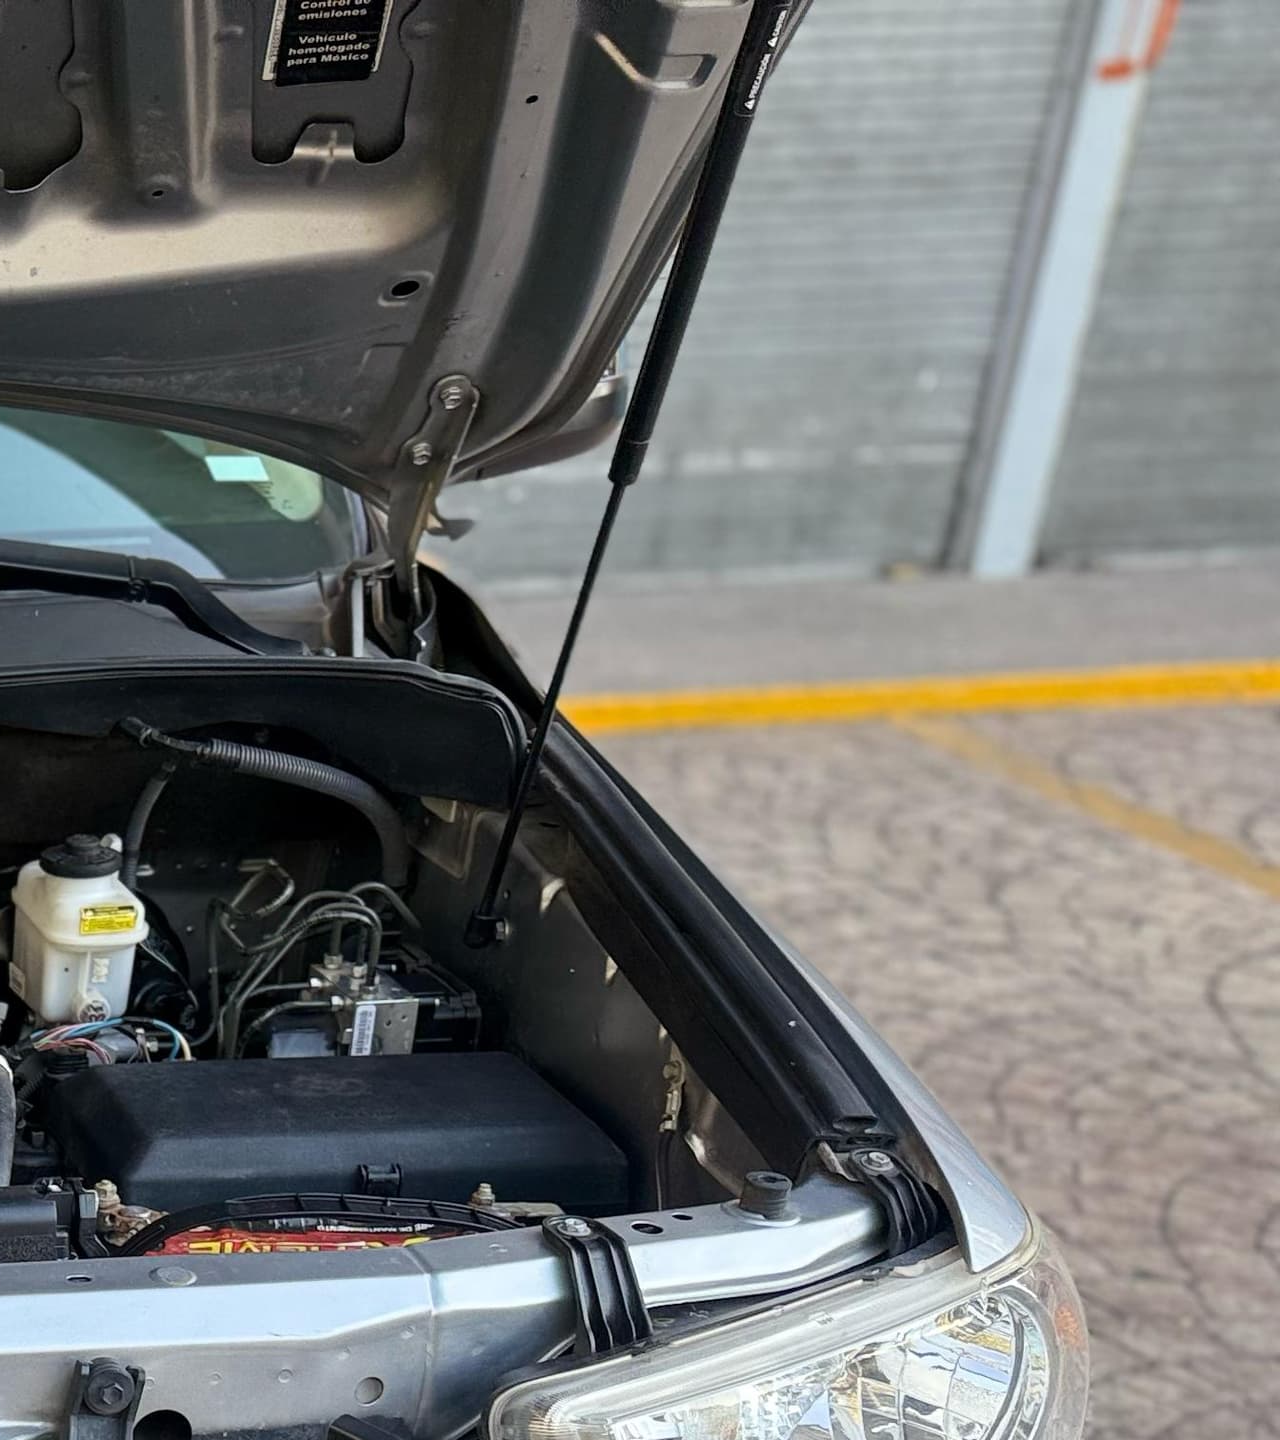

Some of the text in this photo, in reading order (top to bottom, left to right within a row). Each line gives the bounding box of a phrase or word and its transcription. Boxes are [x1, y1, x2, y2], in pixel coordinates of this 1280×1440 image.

[301, 0, 351, 9] Control
[298, 8, 368, 20] emisiones
[288, 42, 370, 56] homologado
[287, 57, 317, 67] para
